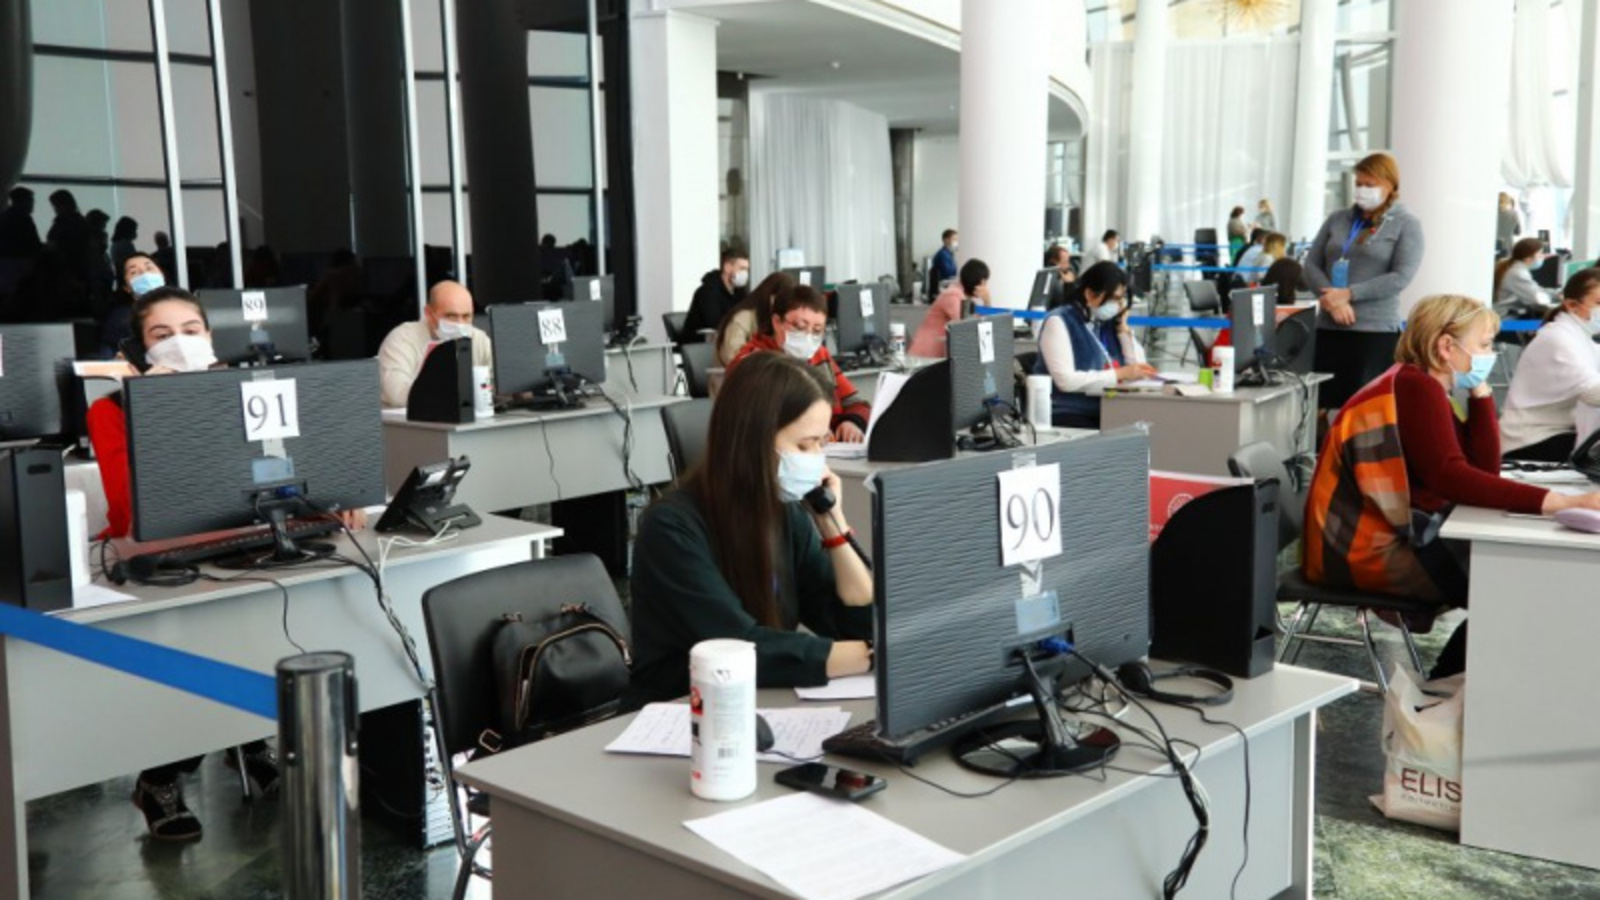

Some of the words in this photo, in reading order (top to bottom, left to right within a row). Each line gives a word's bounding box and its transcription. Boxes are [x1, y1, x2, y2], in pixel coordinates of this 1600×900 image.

[541, 317, 563, 337] 88
[247, 393, 287, 432] 91
[1005, 486, 1055, 551] 90
[1401, 767, 1462, 803] ELIS
